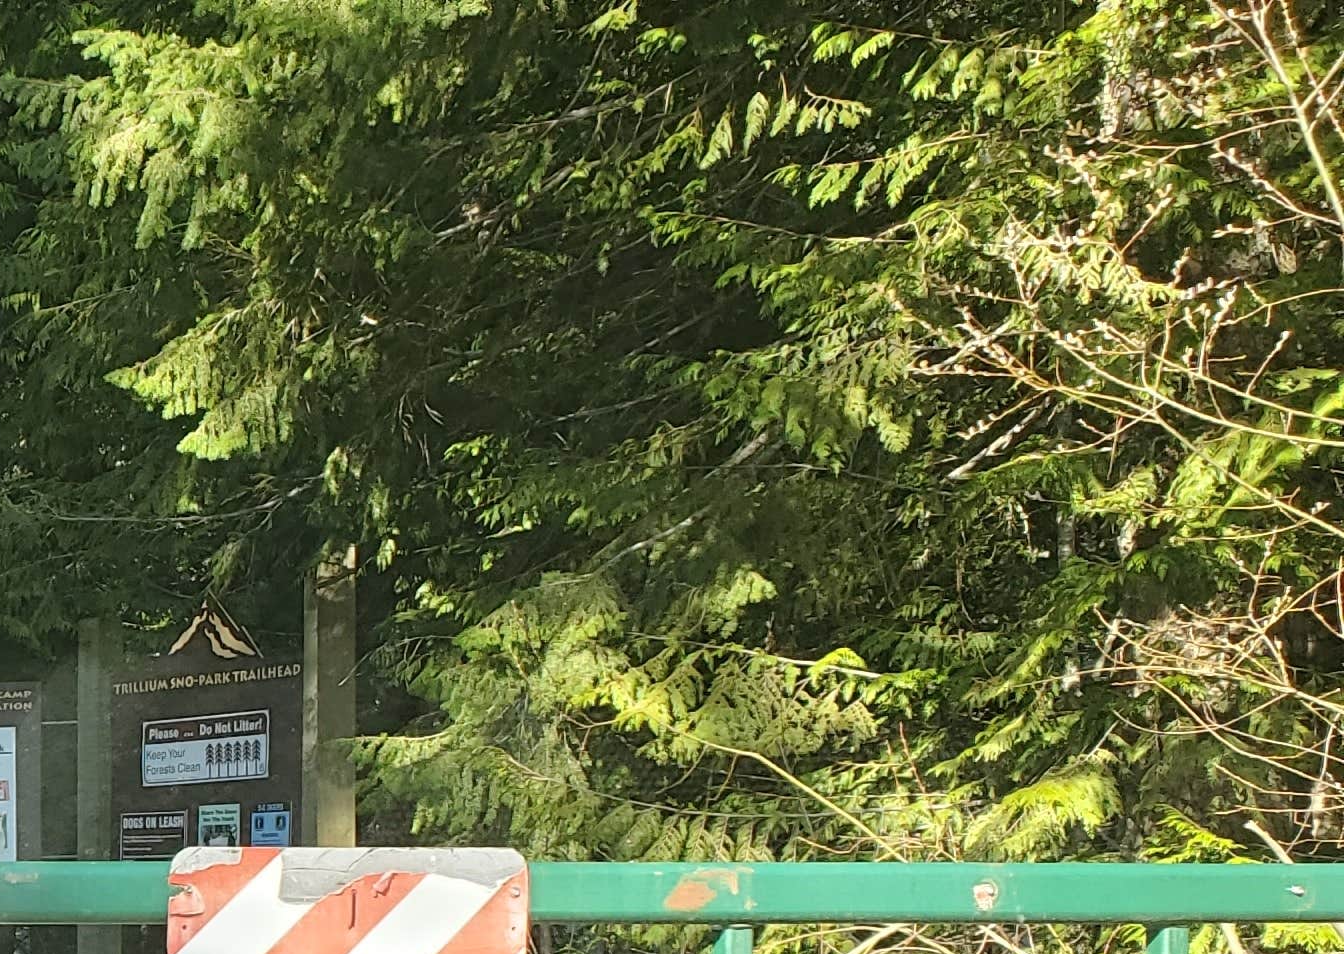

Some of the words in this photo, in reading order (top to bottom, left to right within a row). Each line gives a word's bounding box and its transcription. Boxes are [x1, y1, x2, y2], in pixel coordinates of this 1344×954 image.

[113, 678, 169, 696] TRILLIUM
[170, 671, 231, 690] SNO-PARK
[232, 664, 302, 683] TRAILHEAD
[148, 728, 180, 740] Please
[199, 723, 213, 736] Do
[214, 721, 232, 734] Not
[233, 717, 263, 732] Litter!
[146, 750, 167, 761] Keep
[168, 748, 186, 758] Your
[146, 764, 176, 775] Forests
[177, 762, 201, 773] Clean
[123, 816, 144, 829] DOGS
[145, 816, 157, 828] ON
[158, 815, 184, 828] LEASH
